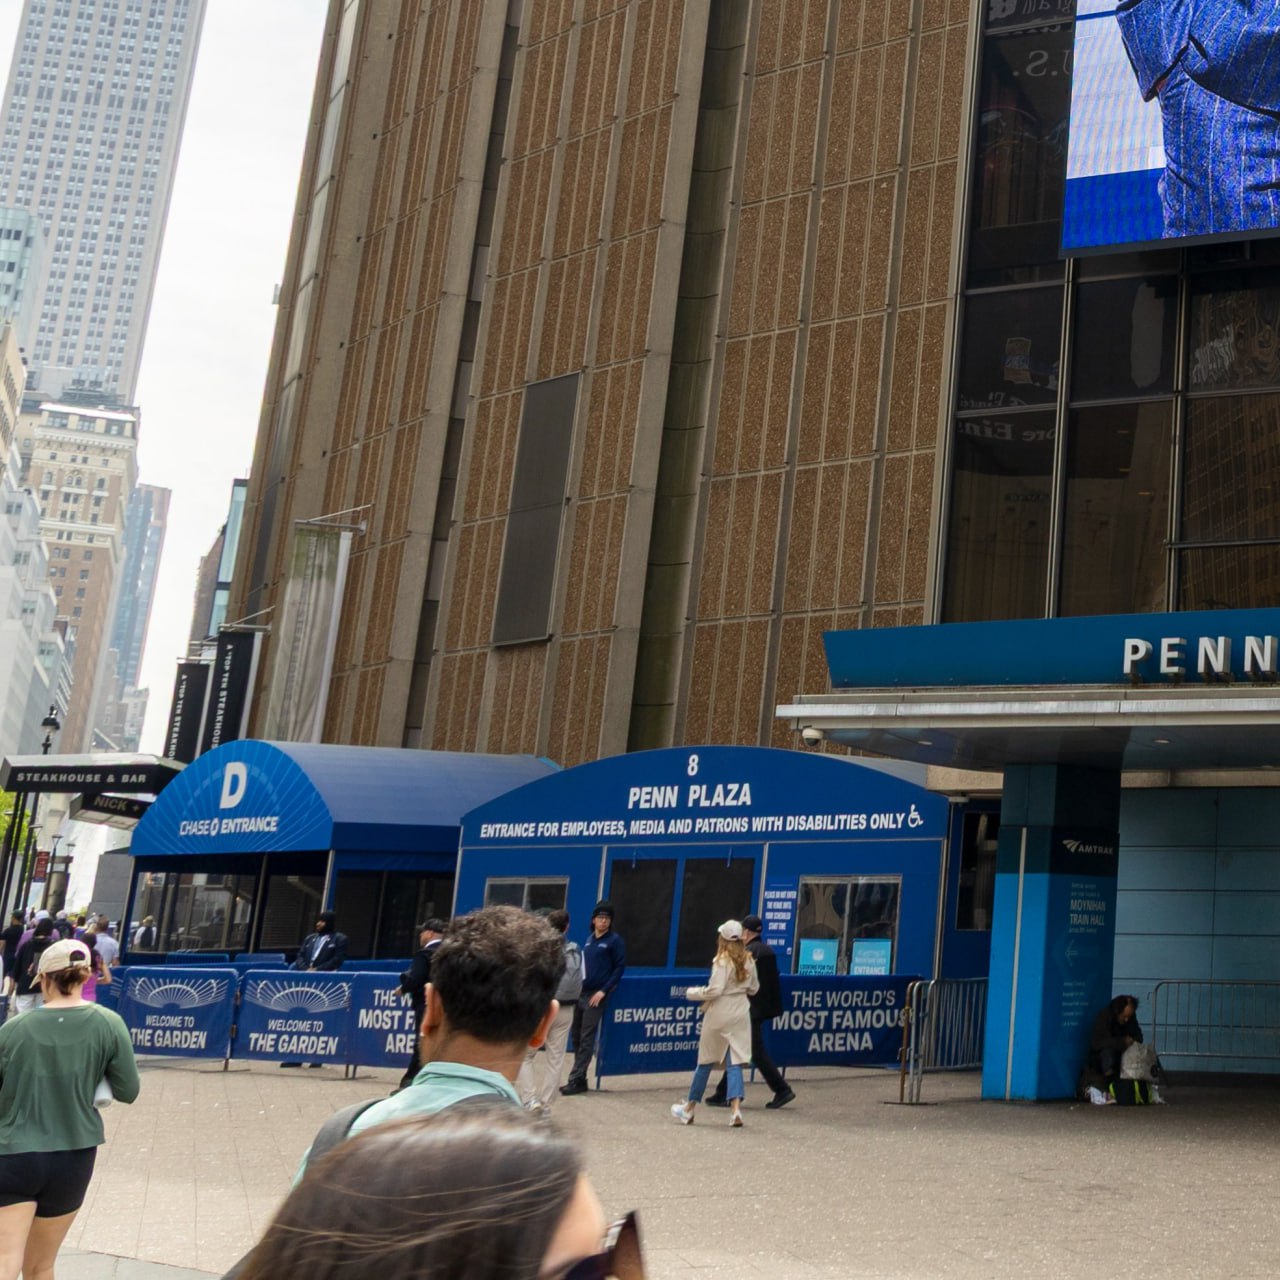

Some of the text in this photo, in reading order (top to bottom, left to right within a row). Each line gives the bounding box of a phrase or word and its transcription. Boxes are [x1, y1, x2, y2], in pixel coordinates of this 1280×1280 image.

[687, 754, 699, 776] 8
[17, 772, 101, 783] STEAKHOUSE
[121, 774, 147, 783] BAR
[219, 761, 248, 809] D
[93, 795, 128, 811] NICK
[628, 783, 752, 810] PENN PLAZA
[179, 816, 279, 836] CHASE ENTRANCE
[480, 812, 906, 839] ENTRANCE FOR EMPLOYEES, MEDIA AND PATRONS WITH DISABILITIES ONLY
[1078, 843, 1114, 856] AMTRAK
[374, 989, 397, 1007] THE
[791, 989, 896, 1009] THE WORLD'S
[145, 1015, 195, 1027] WELCOME TO
[359, 1008, 405, 1029] MOST
[614, 1007, 673, 1023] BEWARE
[676, 1007, 694, 1022] OF
[772, 1010, 829, 1031] MOST
[267, 1019, 323, 1033] WELCOME TO
[645, 1021, 693, 1038] TICKET
[131, 1028, 207, 1049] THE GARDEN
[249, 1033, 338, 1055] THE GARDEN
[385, 1034, 415, 1054] ARE
[630, 1043, 649, 1053] MSG
[651, 1042, 673, 1052] USES
[808, 1032, 873, 1053] ARENA
